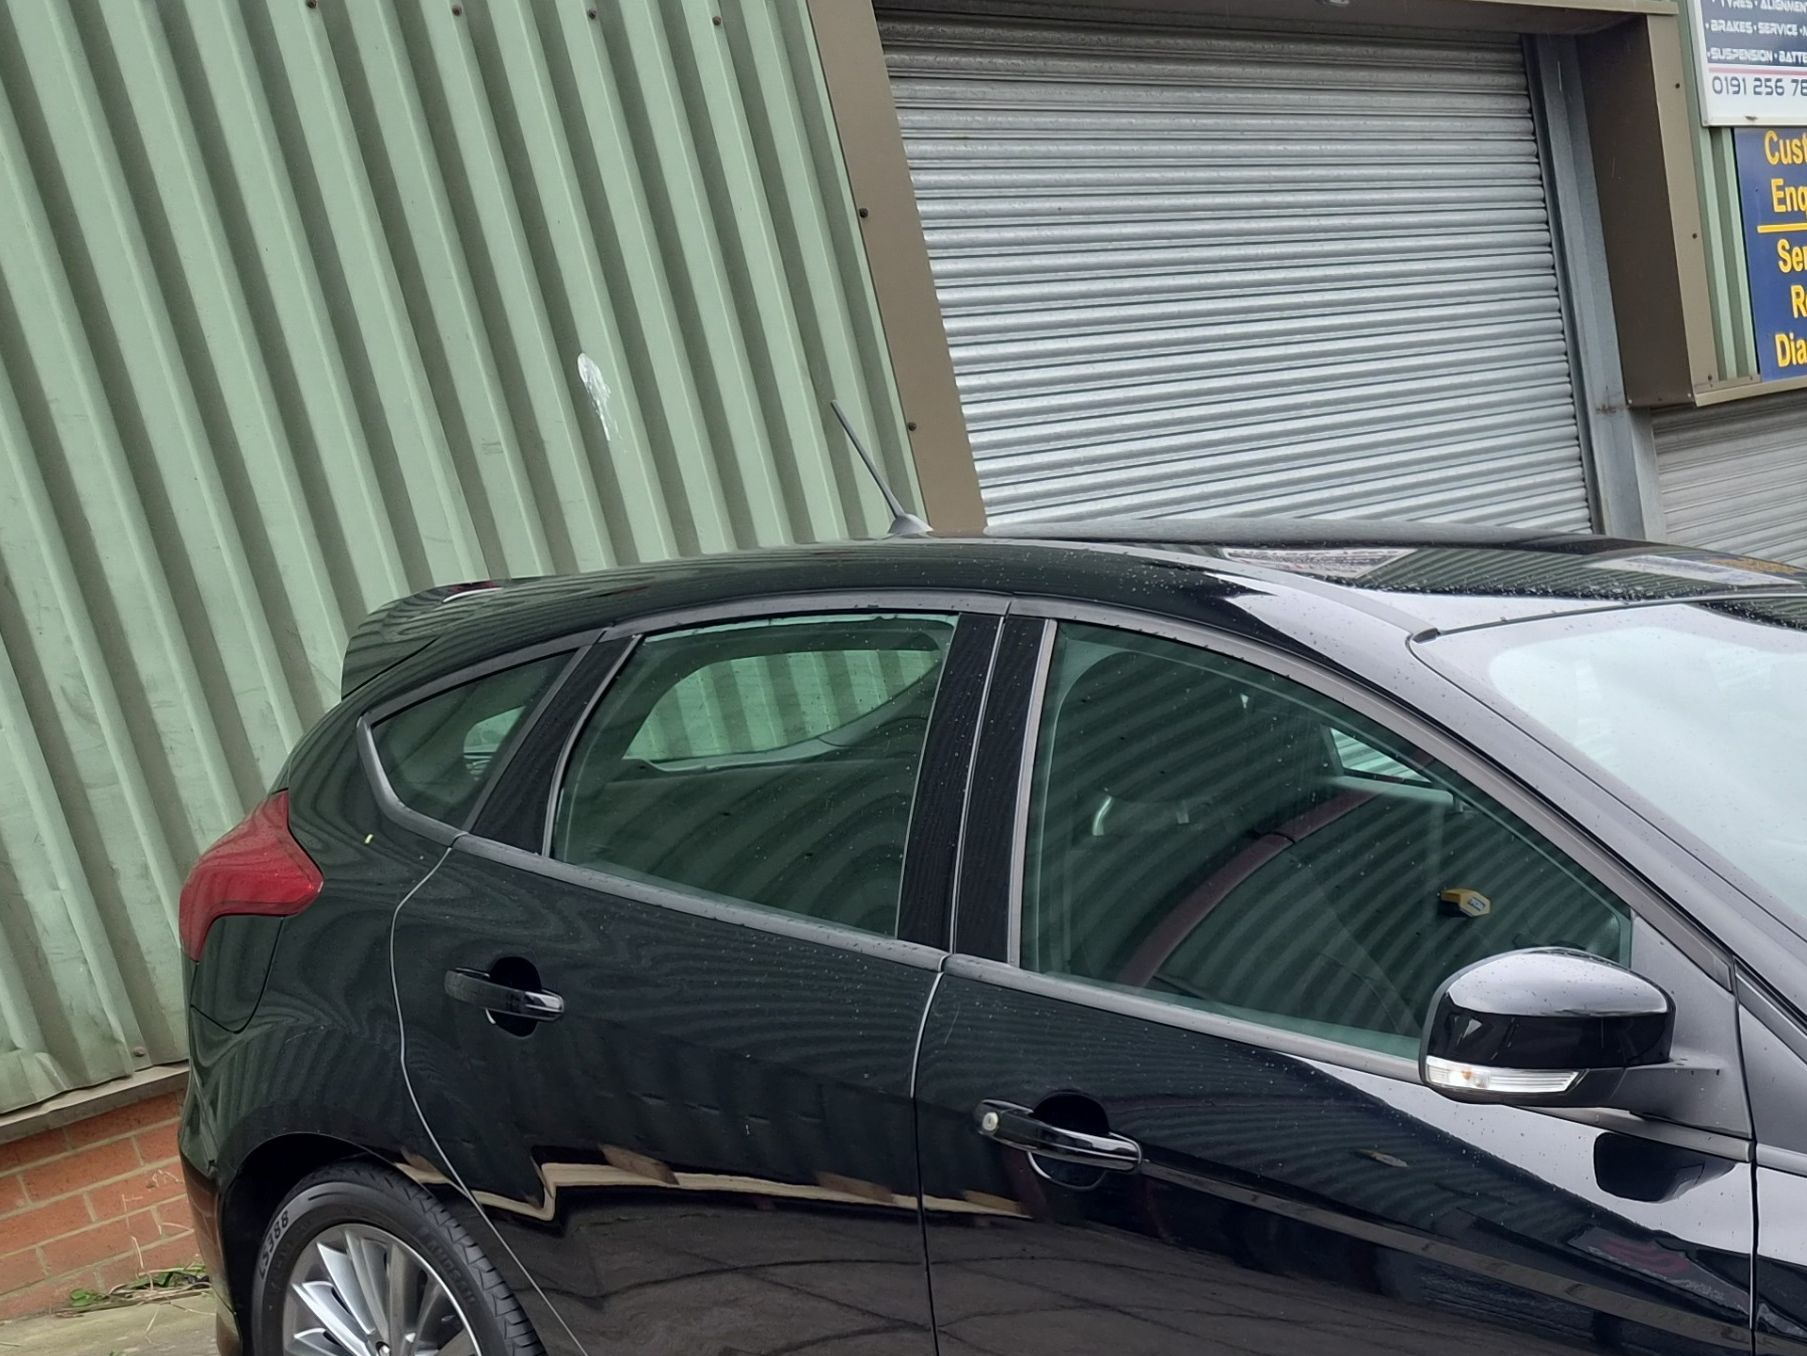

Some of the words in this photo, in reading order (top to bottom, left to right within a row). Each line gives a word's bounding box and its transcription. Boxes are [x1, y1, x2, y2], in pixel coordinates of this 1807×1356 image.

[1710, 19, 1752, 34] BRAKES
[1757, 21, 1798, 36] SERVICE
[1709, 47, 1773, 62] SUSPENSION
[1711, 75, 1748, 95] 0191
[1752, 77, 1785, 96] 256
